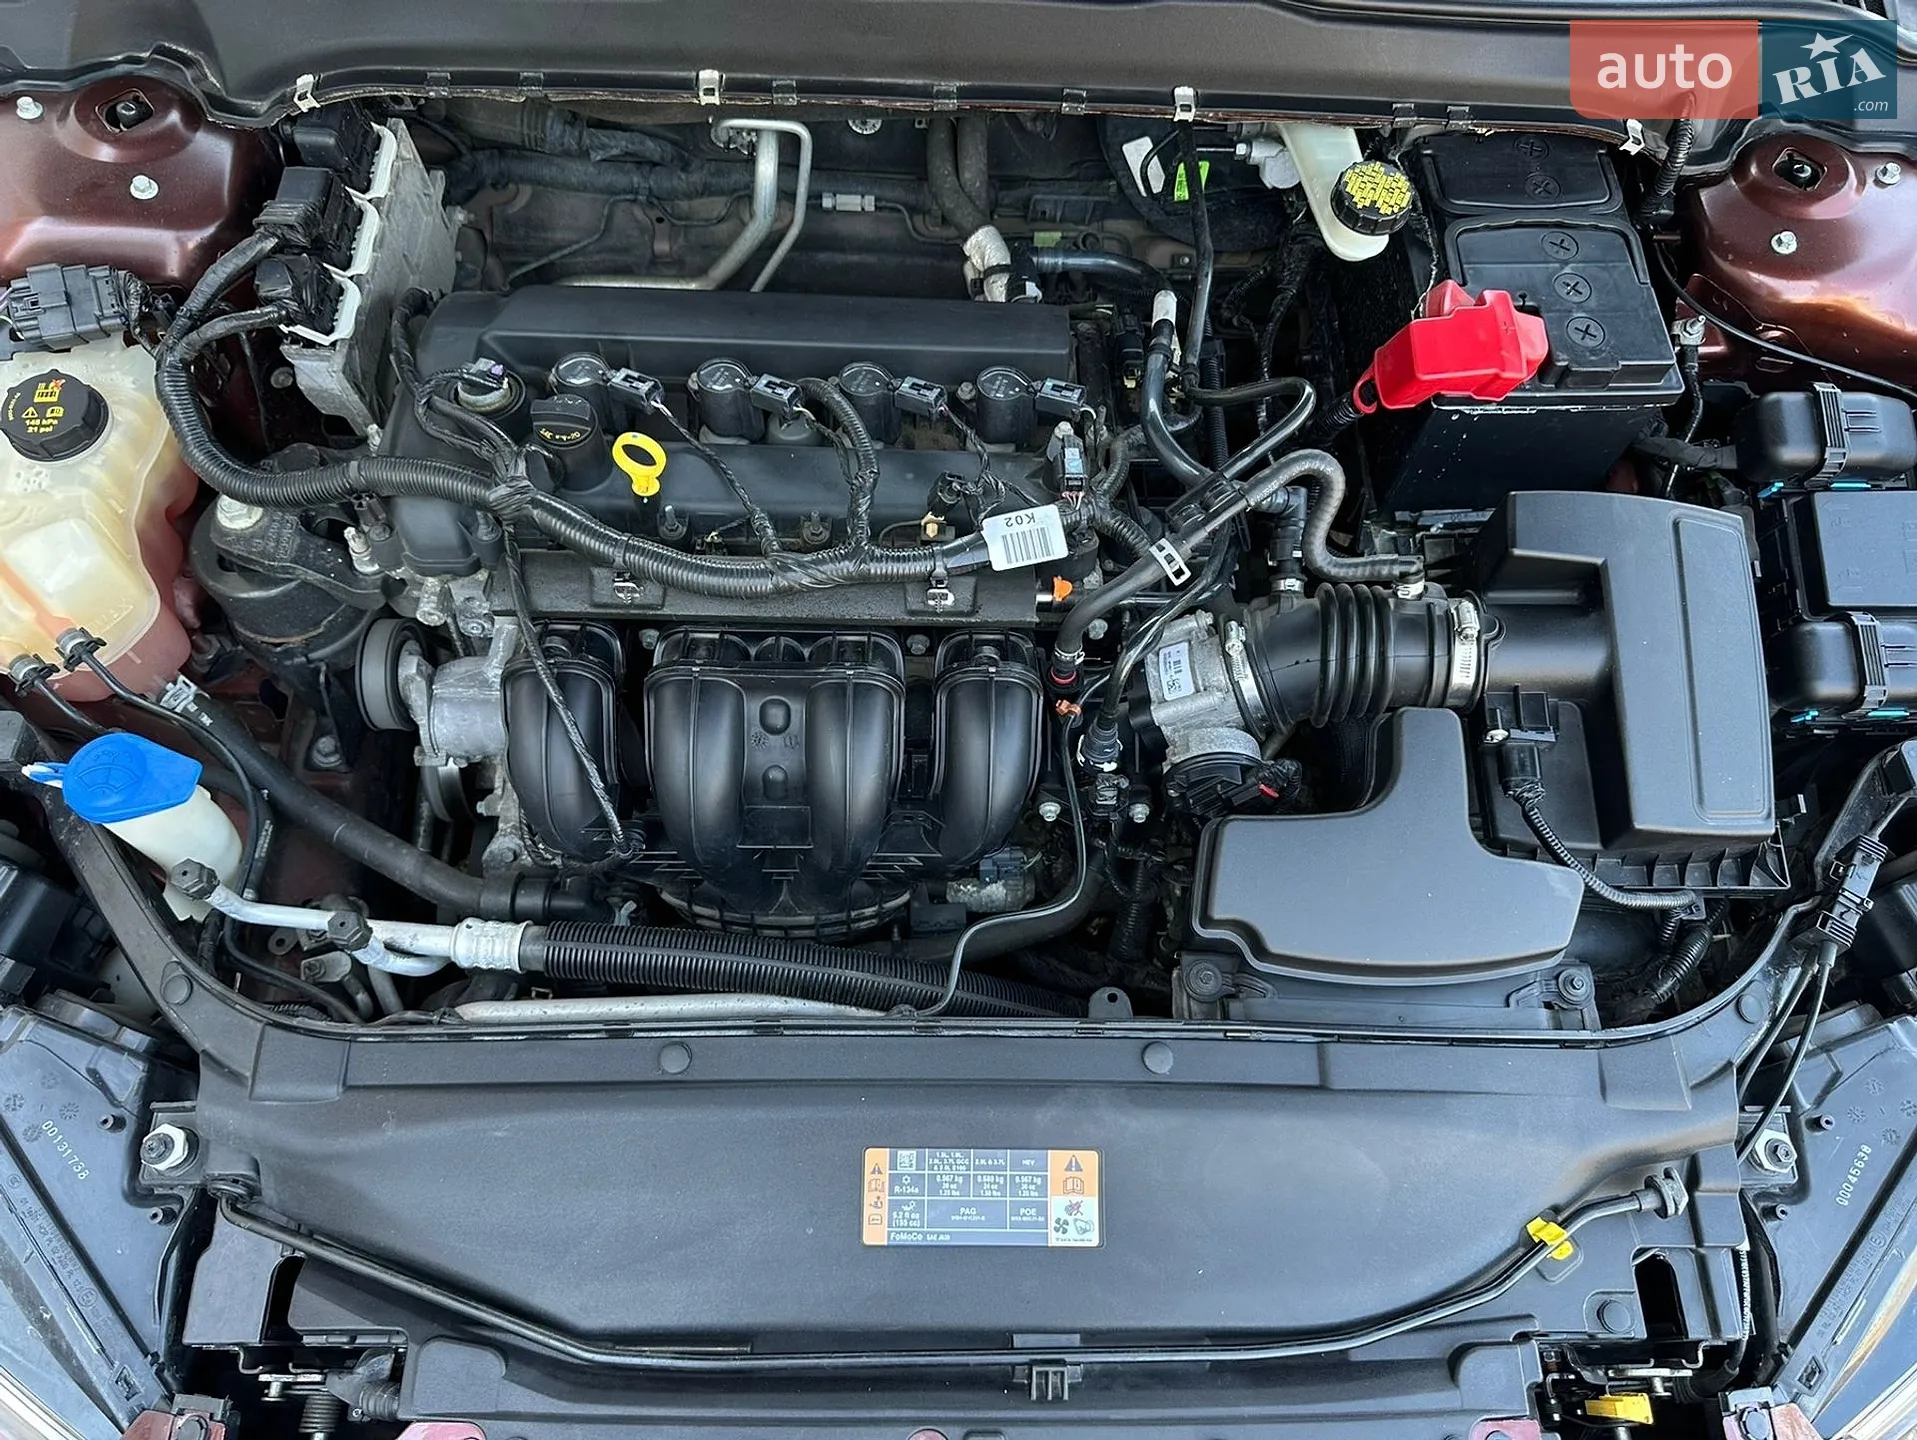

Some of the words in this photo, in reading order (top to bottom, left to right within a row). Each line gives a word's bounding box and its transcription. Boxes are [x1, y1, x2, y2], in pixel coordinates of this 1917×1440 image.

[1004, 512, 1036, 527] K02
[42, 1120, 89, 1180] 00131738
[1836, 1144, 1872, 1206] 00045638
[960, 1207, 977, 1215] PAG
[1020, 1207, 1037, 1216] POE
[890, 1232, 923, 1241] FoMoCo
